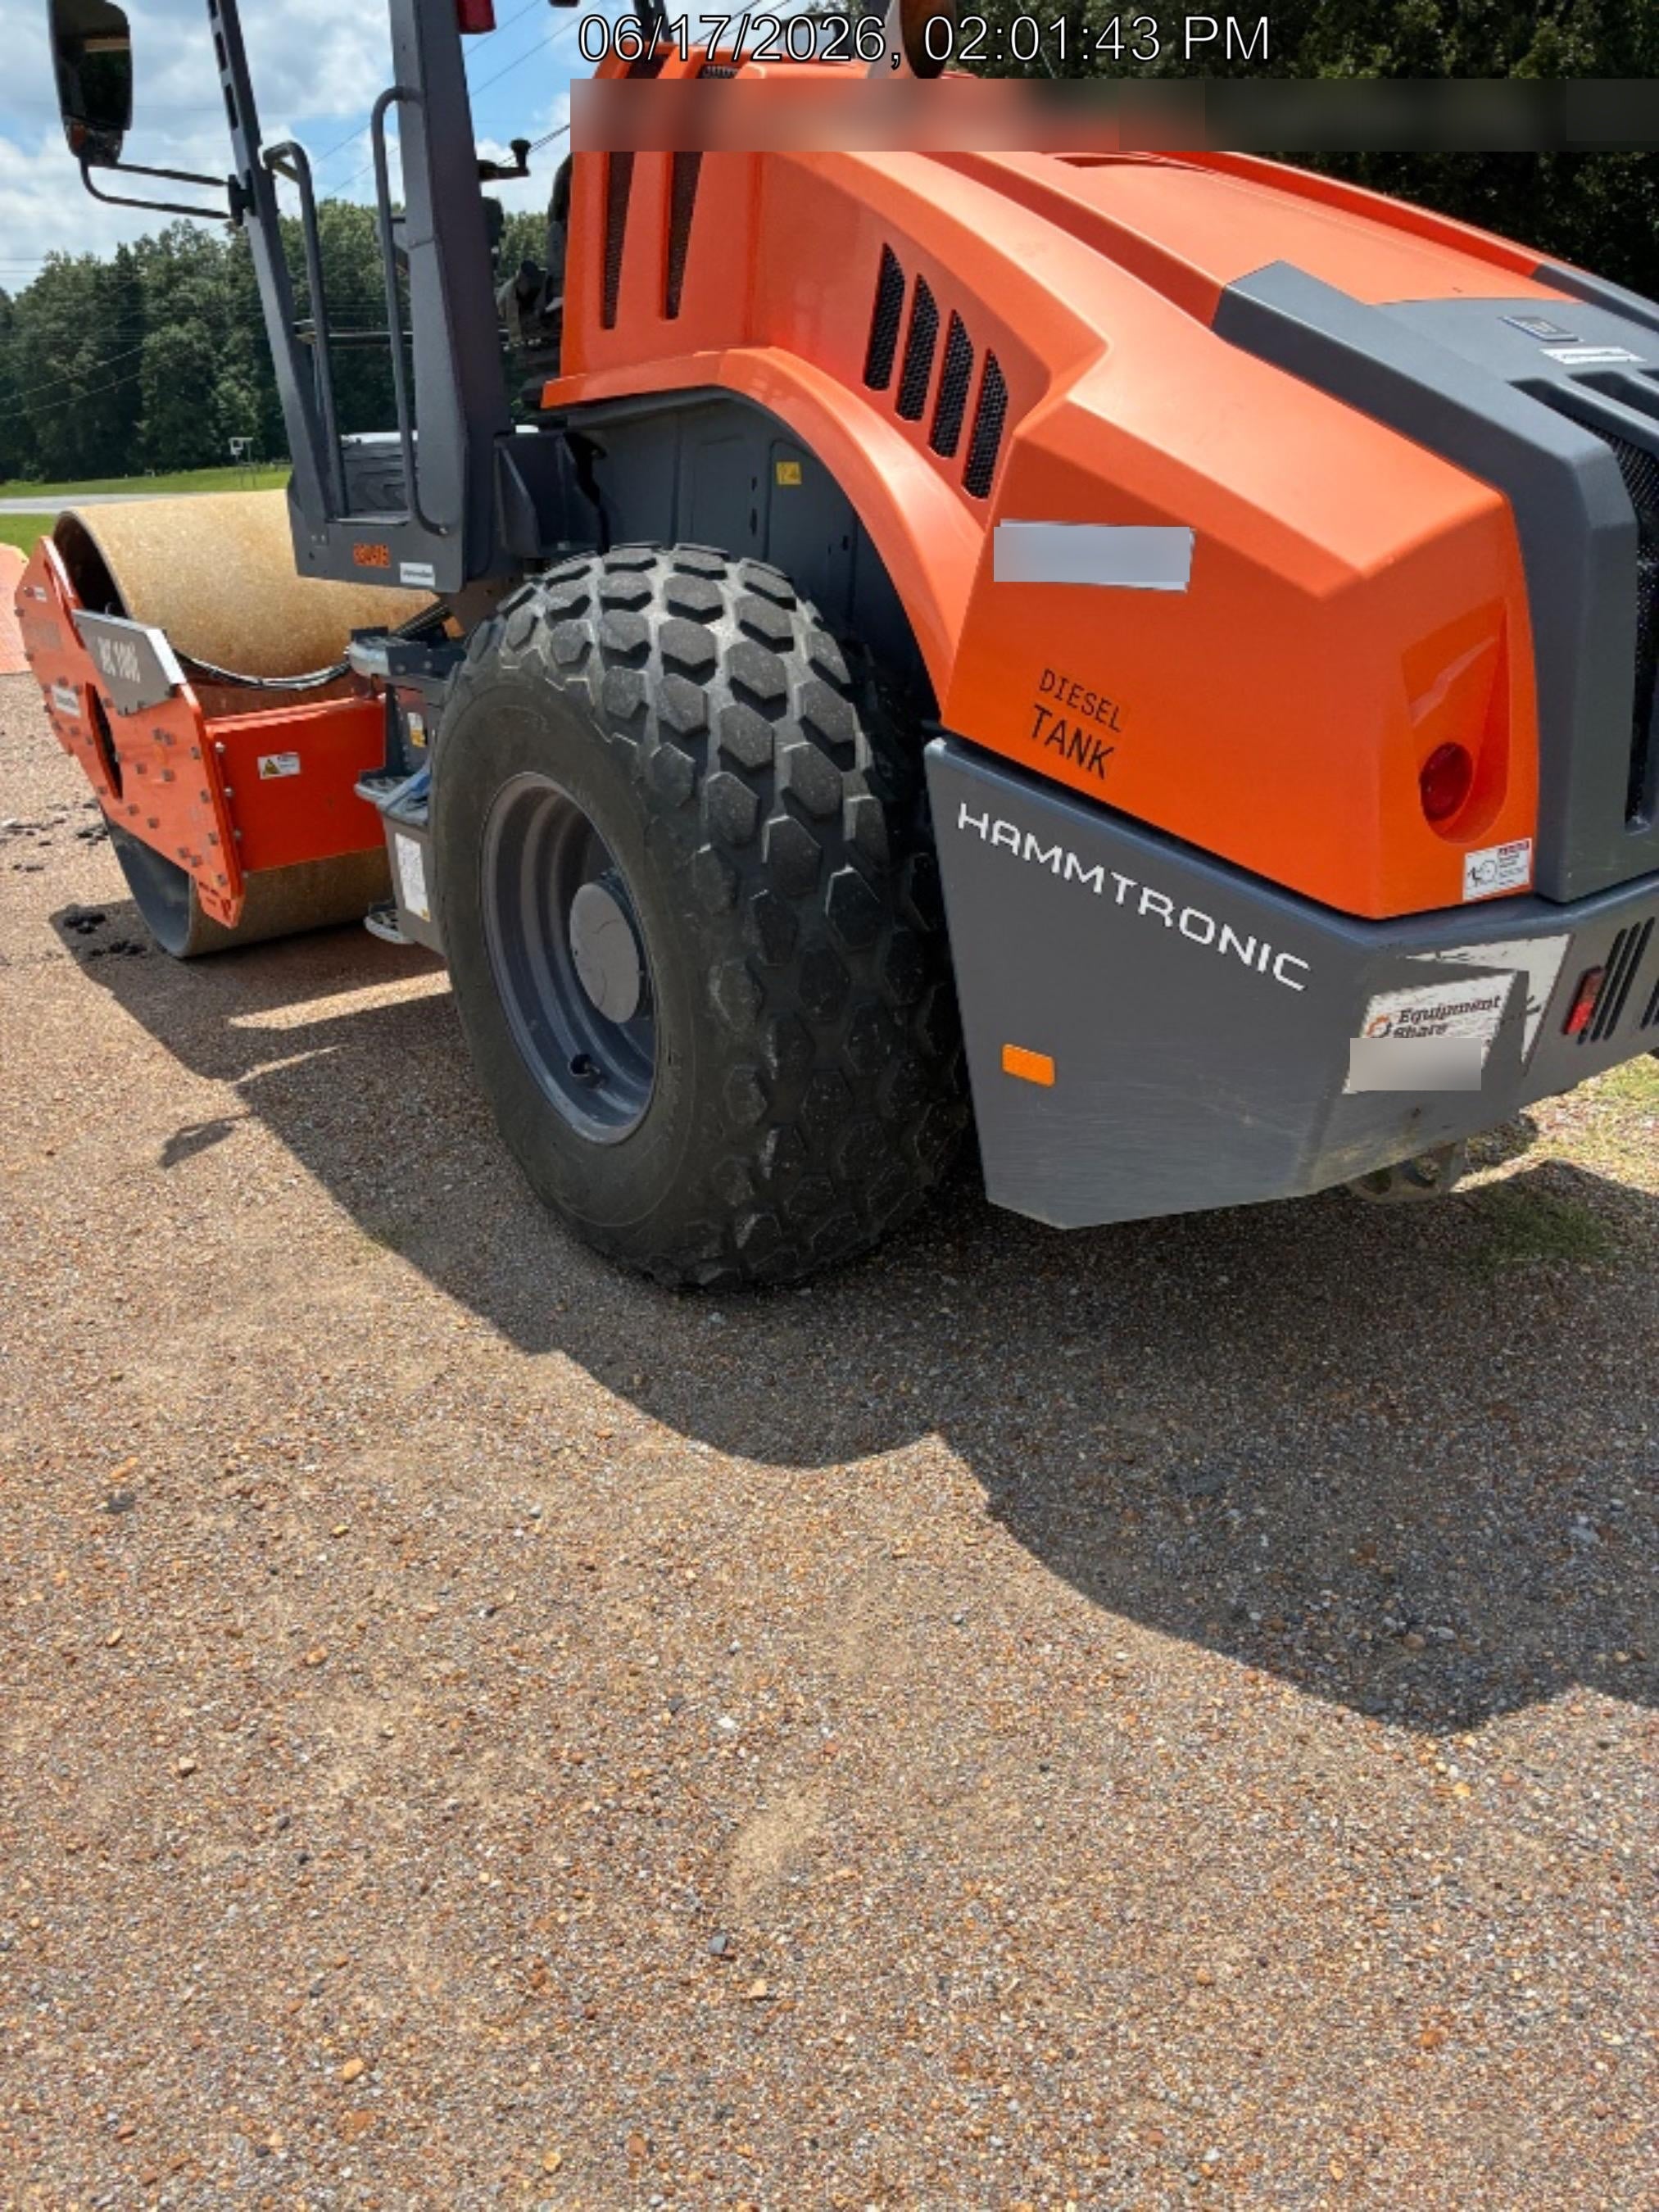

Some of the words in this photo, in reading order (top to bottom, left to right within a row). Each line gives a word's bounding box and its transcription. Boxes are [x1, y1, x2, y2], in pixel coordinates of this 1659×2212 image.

[1039, 669, 1122, 733] DIESEL
[1032, 703, 1115, 780] TANK
[957, 802, 1311, 992] HAMMTRONIC
[1397, 995, 1501, 1025] Equipment
